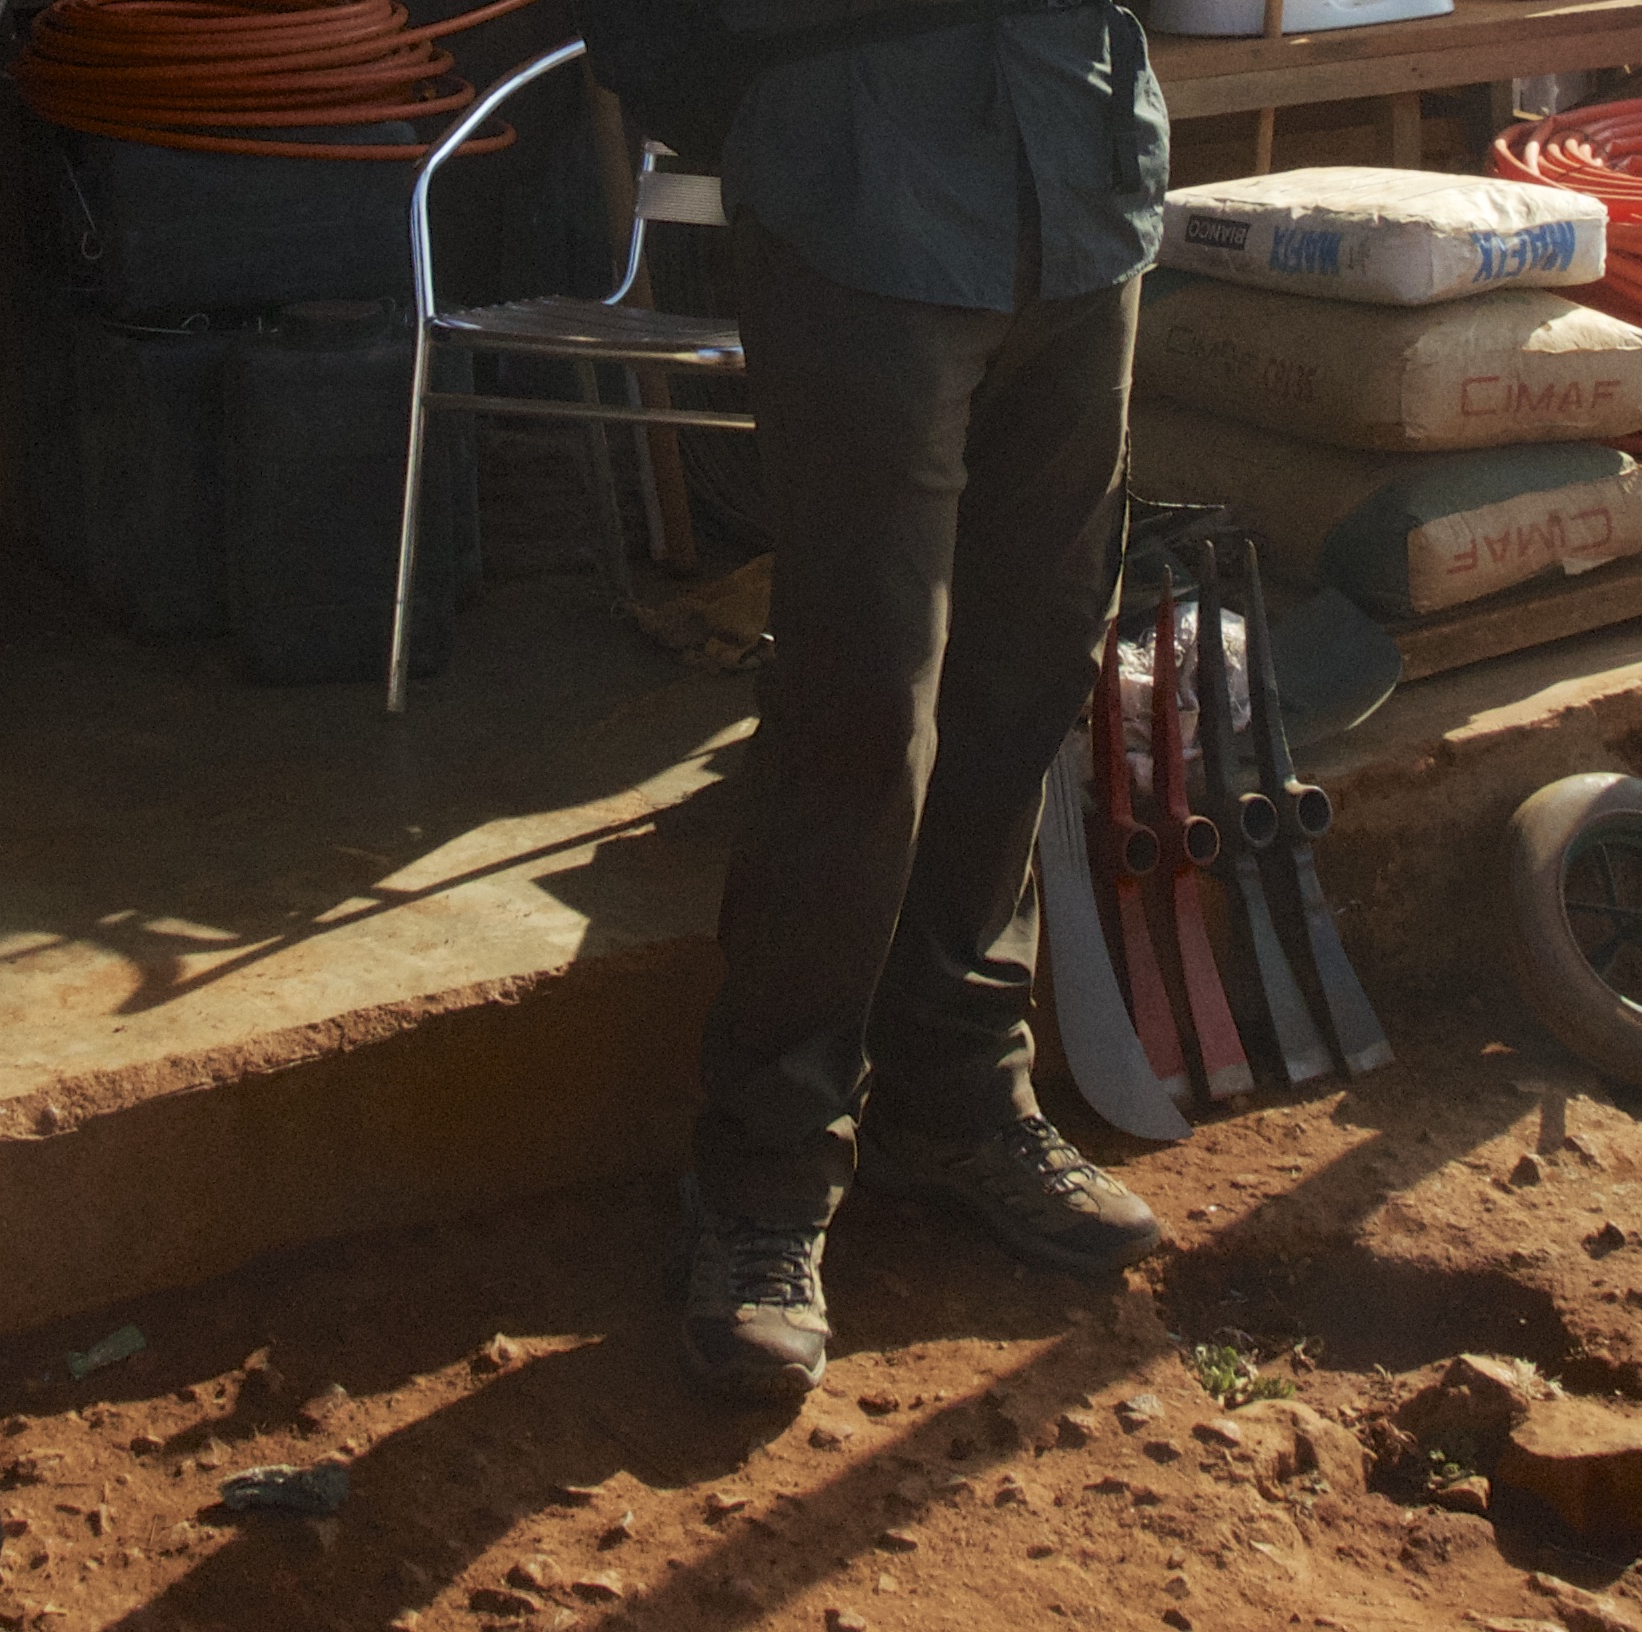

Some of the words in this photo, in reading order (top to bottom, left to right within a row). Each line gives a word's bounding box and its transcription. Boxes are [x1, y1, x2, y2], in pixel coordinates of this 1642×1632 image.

[1187, 217, 1247, 247] BIANCO
[1461, 375, 1621, 417] CIMAF
[1450, 507, 1614, 575] CIMAF
